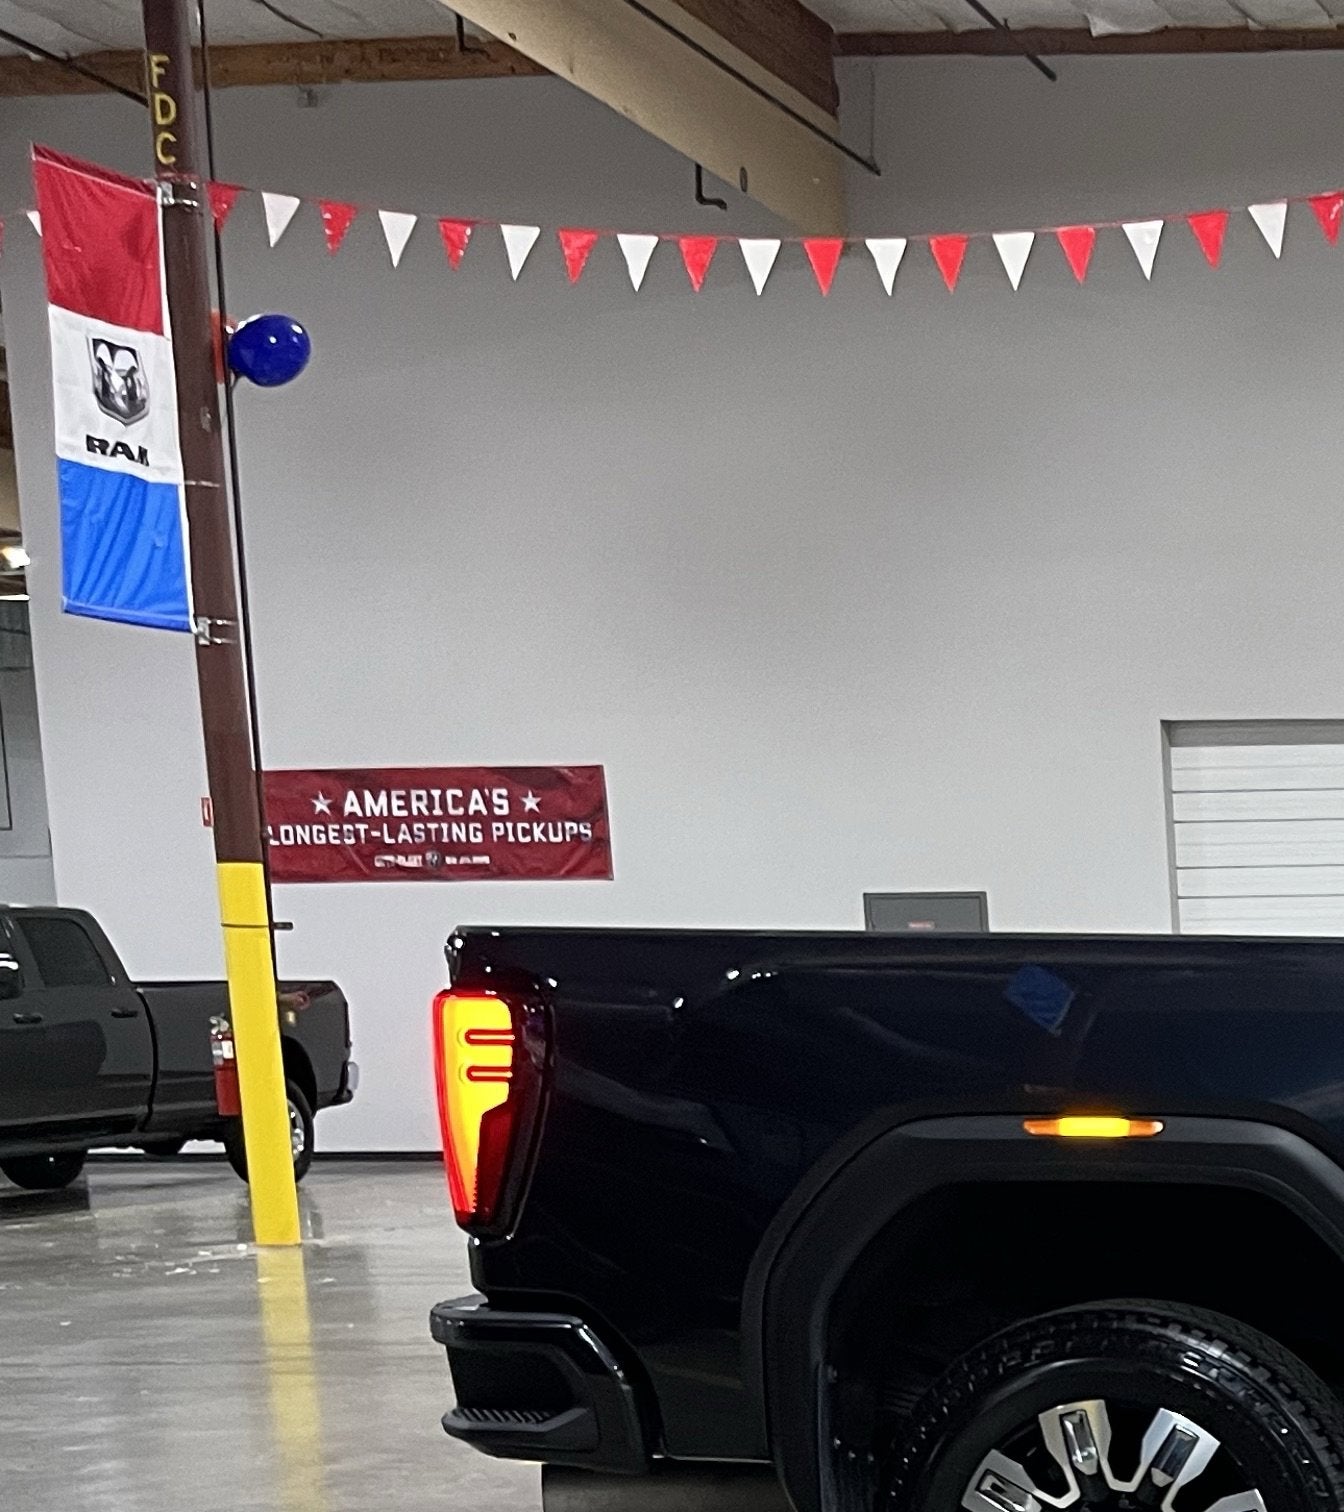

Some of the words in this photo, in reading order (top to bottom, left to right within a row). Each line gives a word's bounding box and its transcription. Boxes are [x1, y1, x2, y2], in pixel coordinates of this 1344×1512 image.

[149, 53, 177, 165] FDC
[343, 788, 509, 817] AMERICA'S
[267, 822, 483, 846] LONGEST-LASTING
[491, 821, 593, 844] PICKUPS
